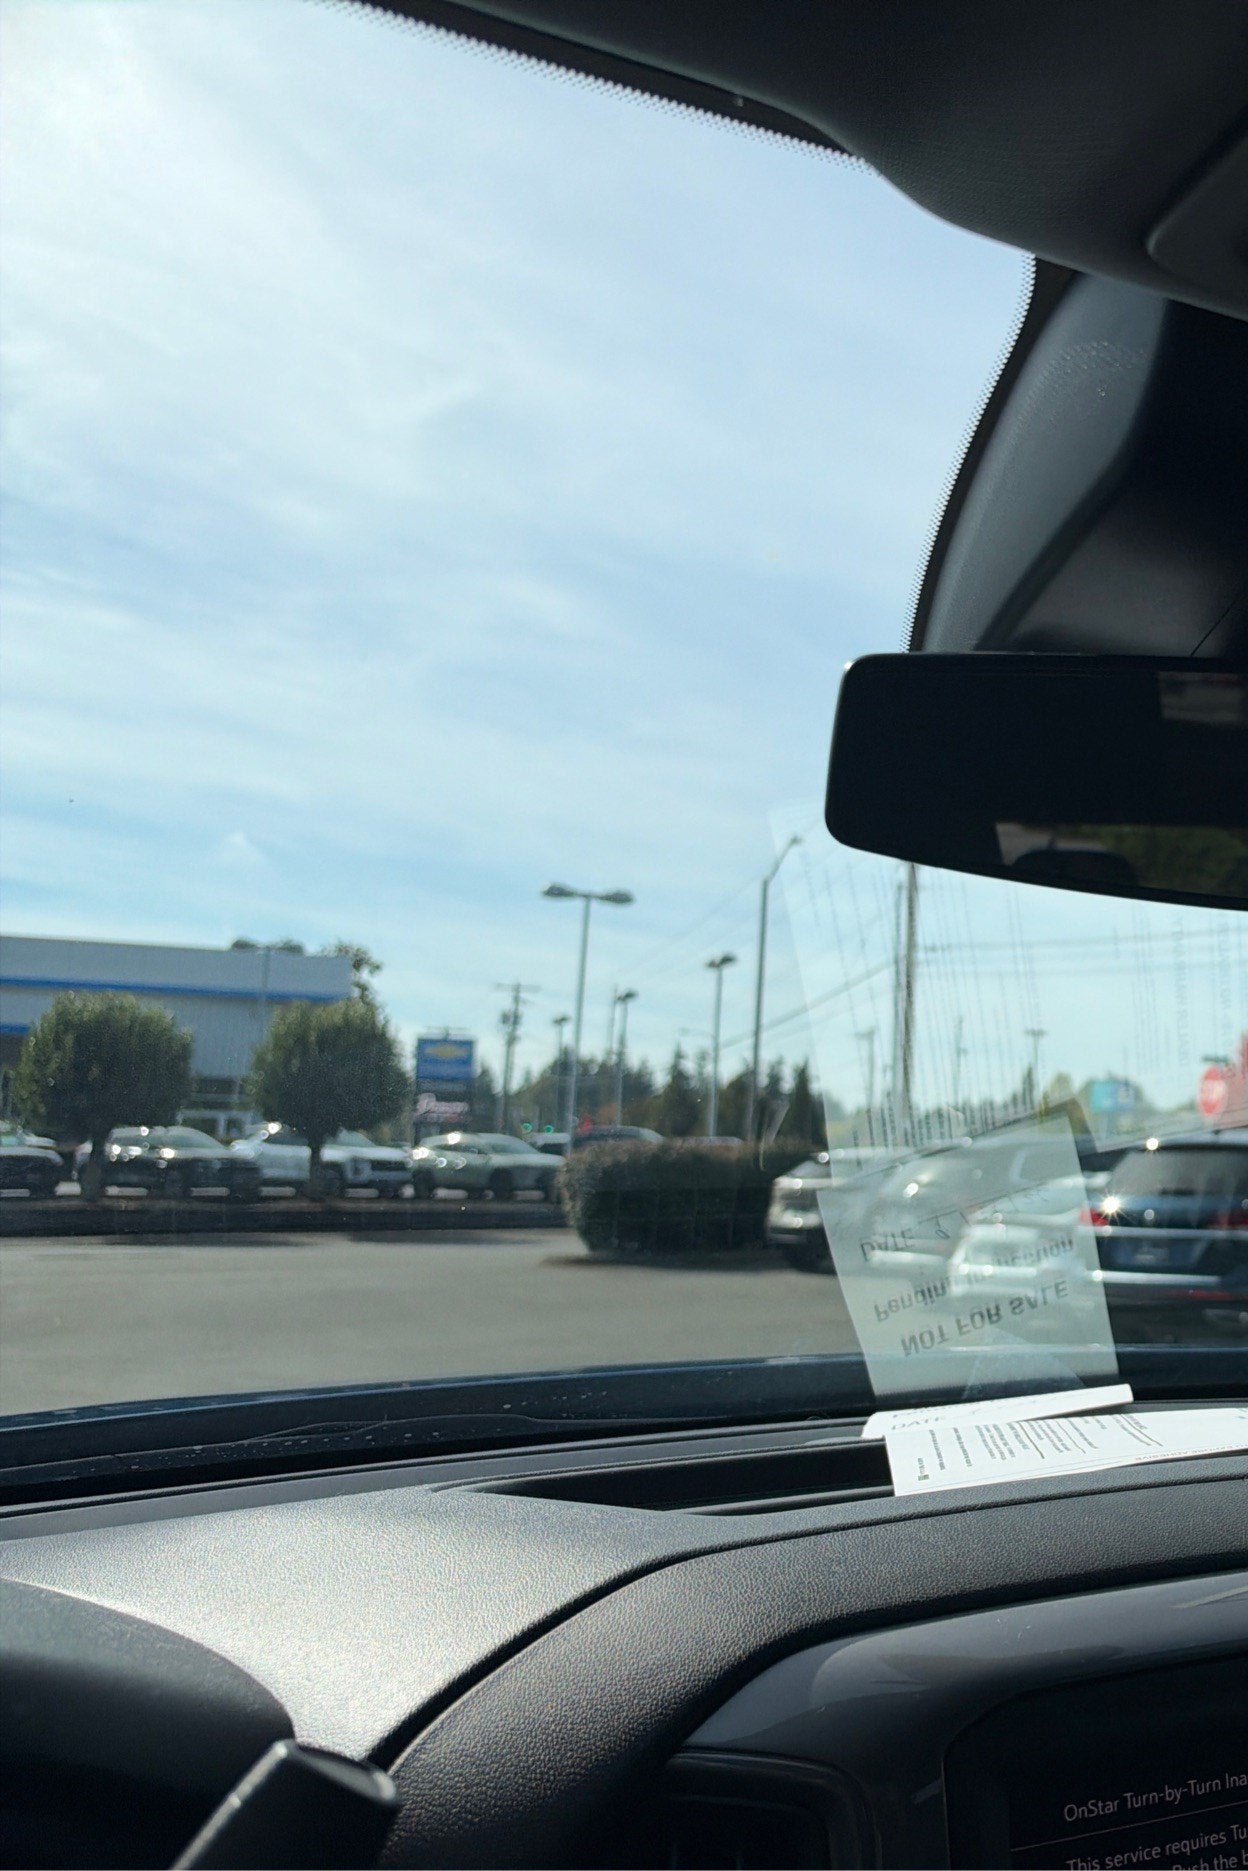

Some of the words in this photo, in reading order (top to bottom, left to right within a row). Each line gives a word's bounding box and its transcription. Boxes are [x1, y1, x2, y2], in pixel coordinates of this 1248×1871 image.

[1063, 1799, 1120, 1822] OnStar
[1123, 1778, 1222, 1810] Turn-by-Turn
[1066, 1857, 1100, 1871] This
[1105, 1844, 1162, 1869] service
[1165, 1831, 1227, 1857] requires
[1213, 1852, 1238, 1870] the
